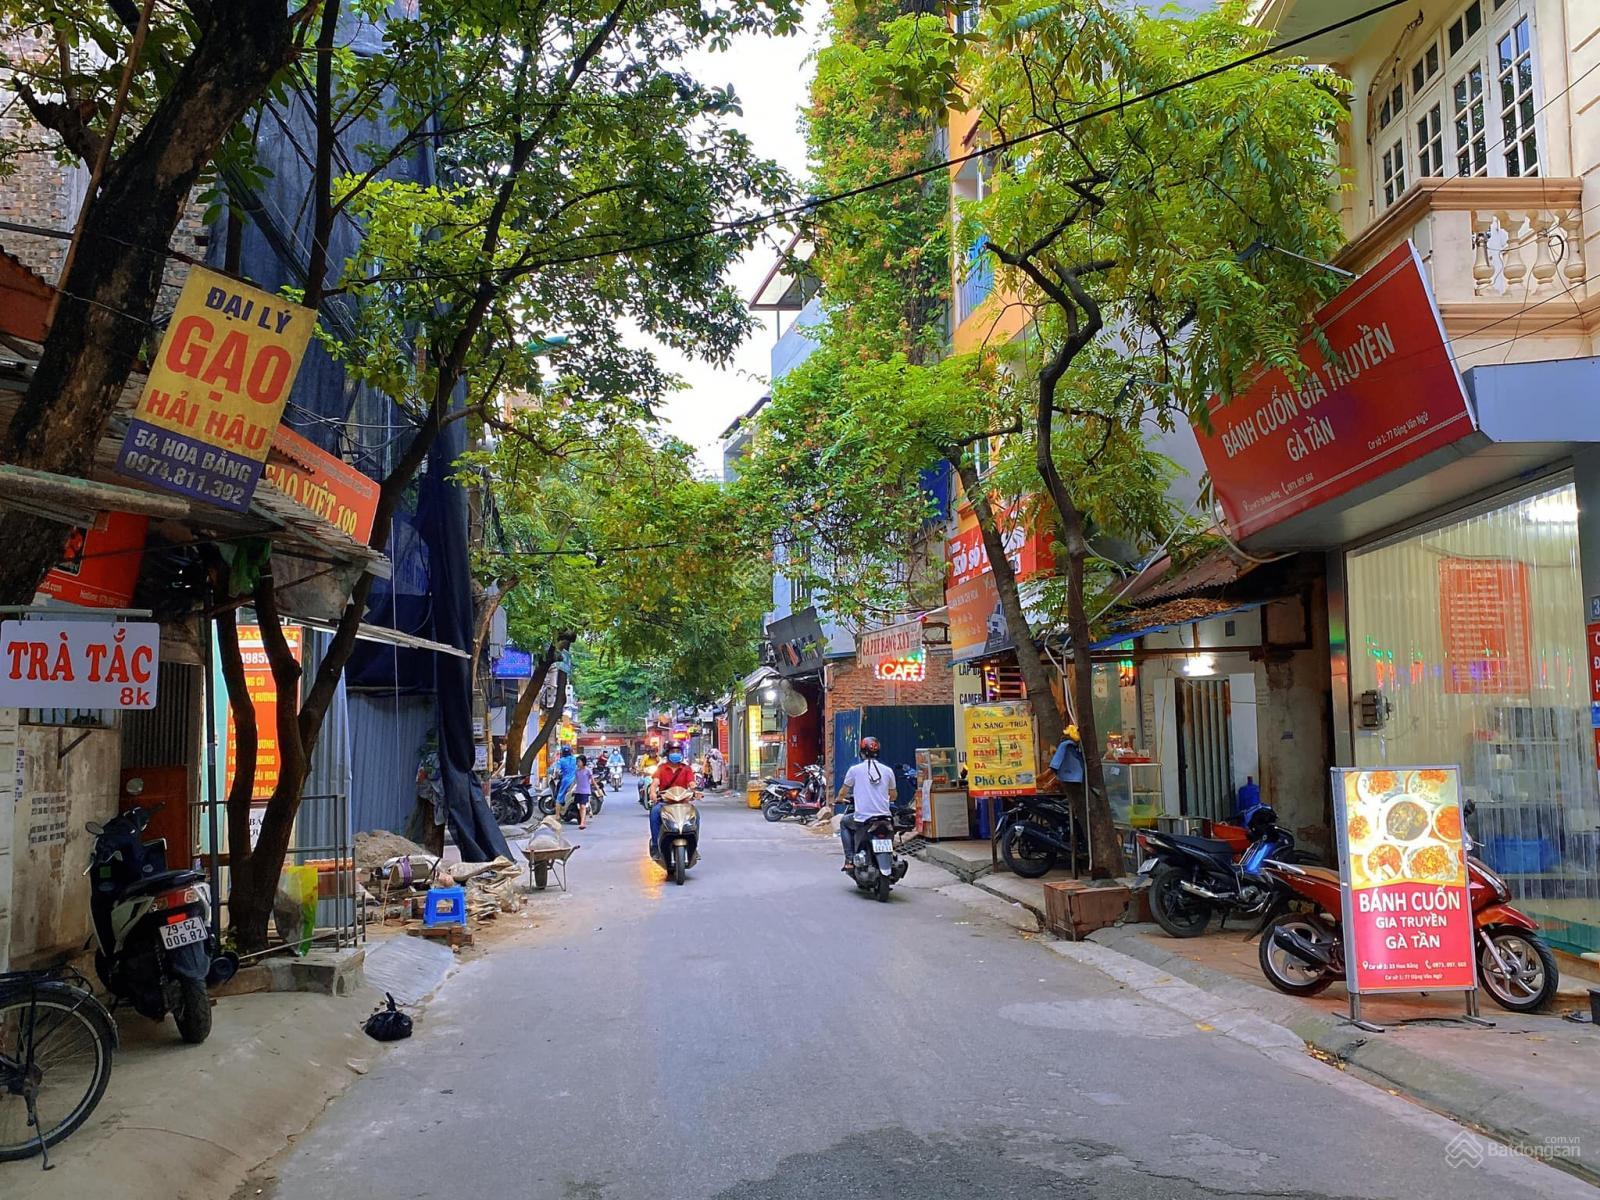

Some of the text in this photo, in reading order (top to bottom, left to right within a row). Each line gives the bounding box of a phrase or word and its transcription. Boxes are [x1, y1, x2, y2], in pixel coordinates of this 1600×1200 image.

[205, 286, 292, 334] ĐẠI LÝ
[165, 315, 292, 404] GẠO
[1221, 416, 1259, 459] BÁNH
[1323, 322, 1396, 392] TRUYỀN
[145, 389, 268, 451] HẢI HẬU
[134, 428, 158, 449] 54
[161, 437, 198, 466] HOA
[1287, 415, 1336, 462] GÀ TẦN
[125, 451, 246, 505] 0974.811.392
[333, 504, 358, 536] 100
[7, 628, 153, 684] TRÀ TẮC
[120, 687, 150, 706] 8k
[975, 774, 1014, 786] Phở Gà
[1359, 883, 1460, 912] BÁNH CUỐN
[166, 920, 197, 936] 29-G2
[1375, 912, 1447, 928] GIA TRUYỀN
[166, 929, 205, 947] 006.82
[1385, 931, 1440, 949] GÀ TẦN
